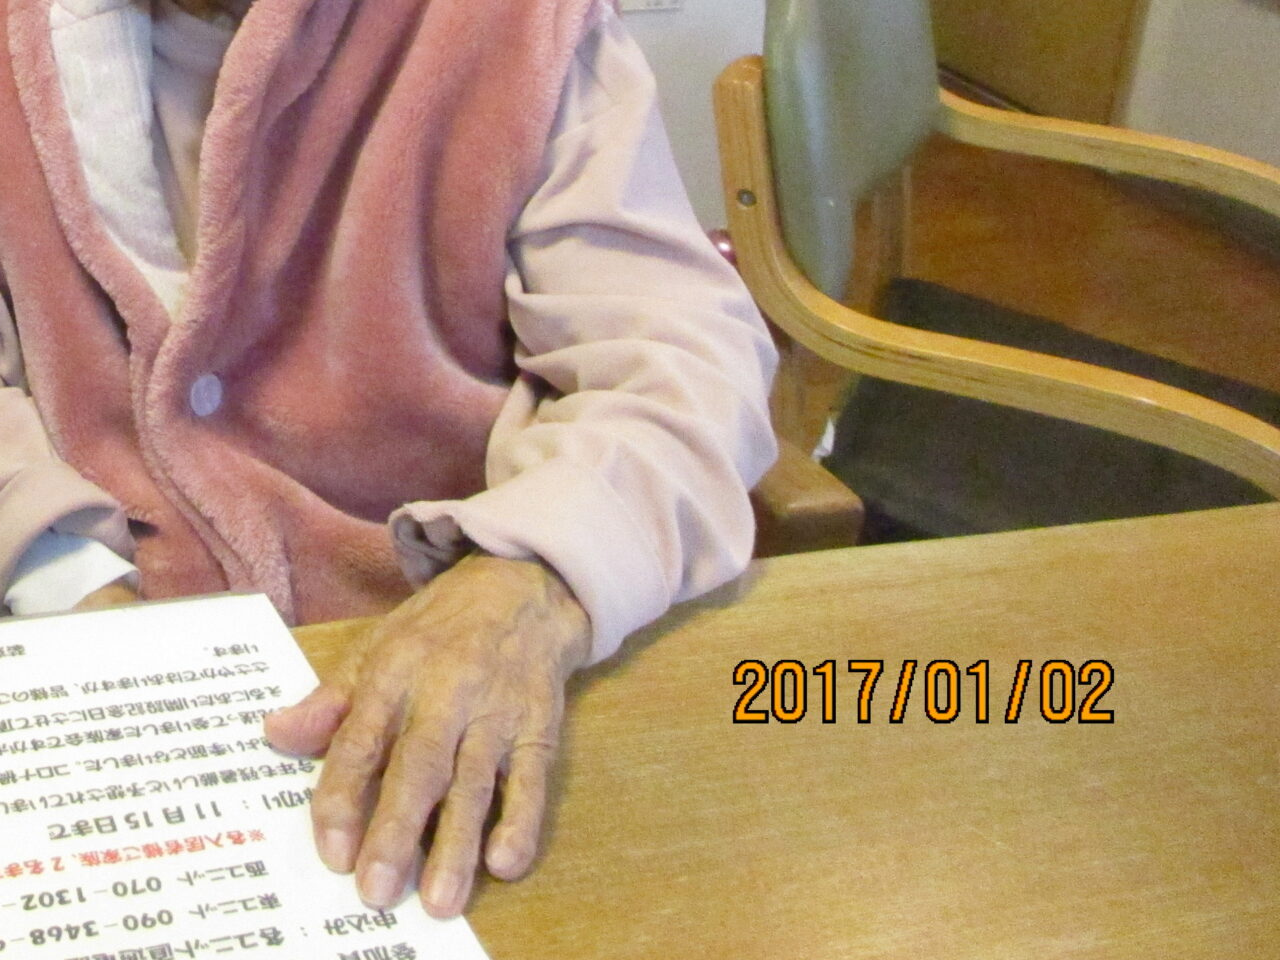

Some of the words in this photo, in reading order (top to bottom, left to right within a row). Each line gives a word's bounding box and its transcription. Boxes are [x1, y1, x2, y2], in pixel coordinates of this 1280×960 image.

[203, 643, 259, 659] ります。
[177, 860, 270, 887] 西ユニット
[188, 892, 283, 920] 東ユニット
